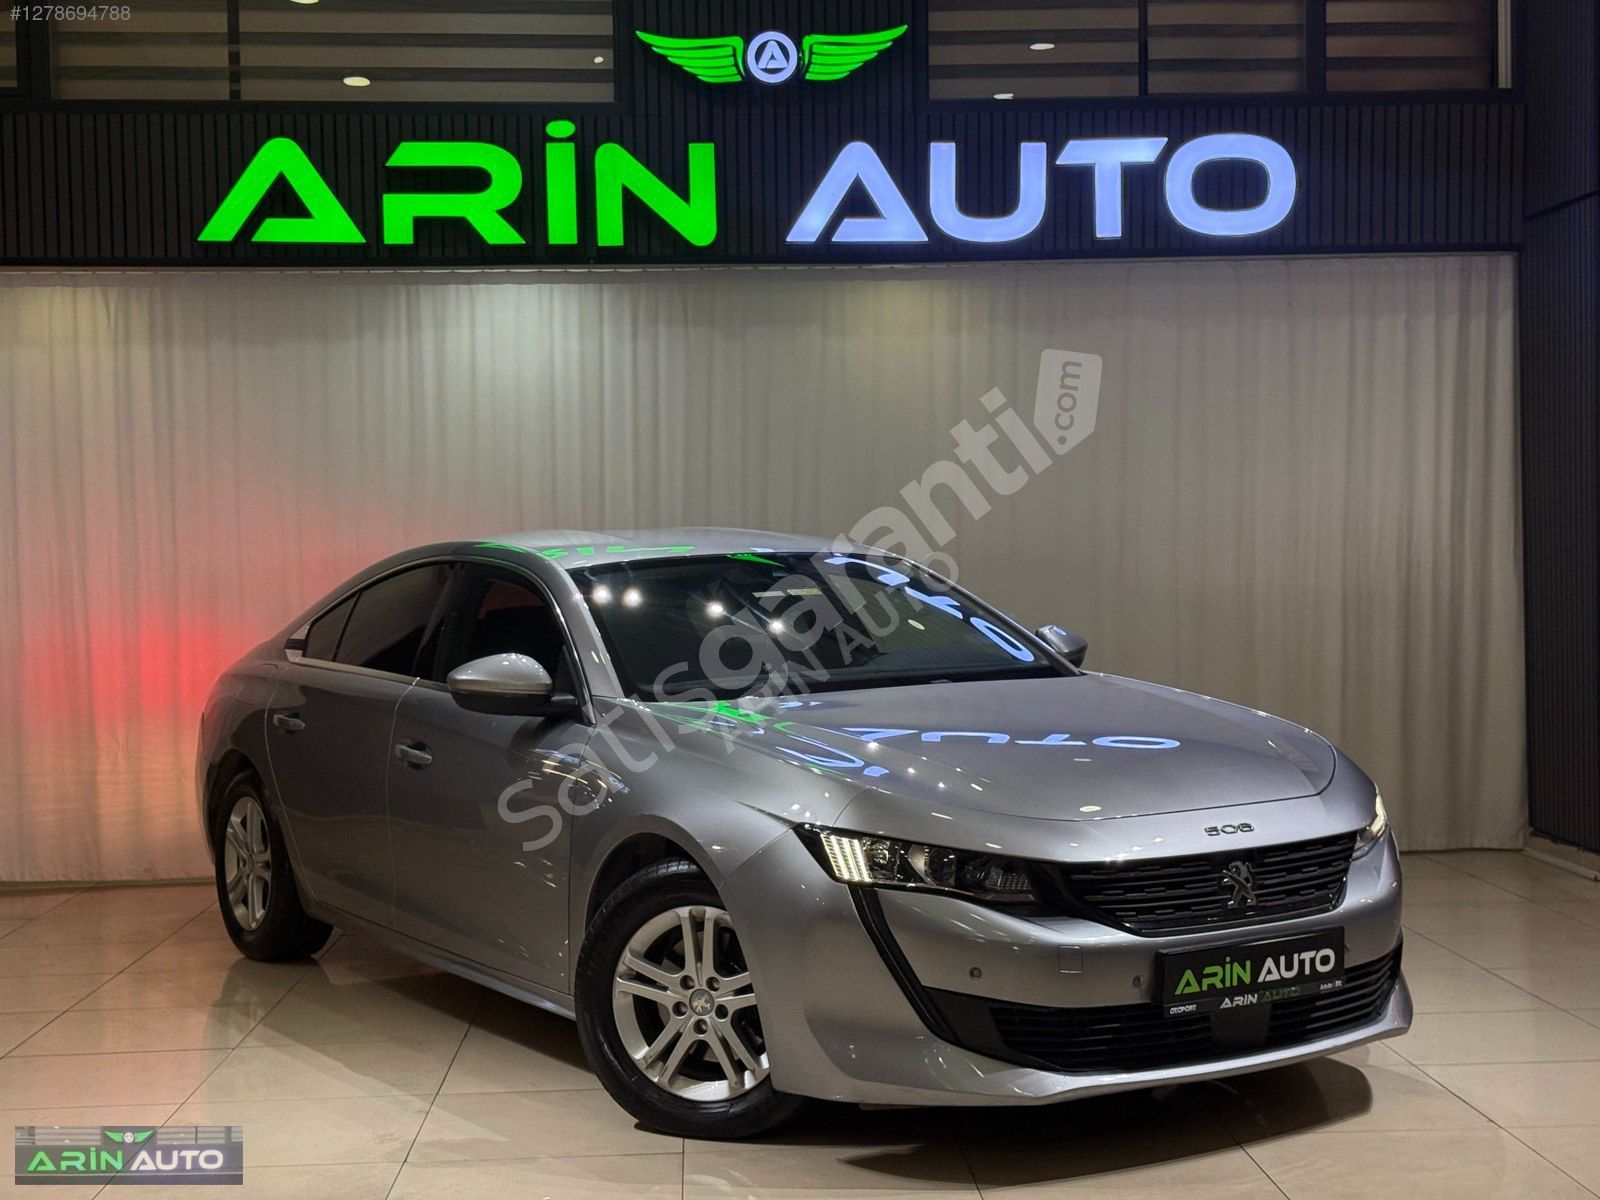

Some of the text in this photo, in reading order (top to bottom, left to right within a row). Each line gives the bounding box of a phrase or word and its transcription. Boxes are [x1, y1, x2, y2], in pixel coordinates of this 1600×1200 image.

[786, 132, 1298, 244] AUTO
[1204, 822, 1255, 837] 508
[1257, 948, 1336, 983] AUTO
